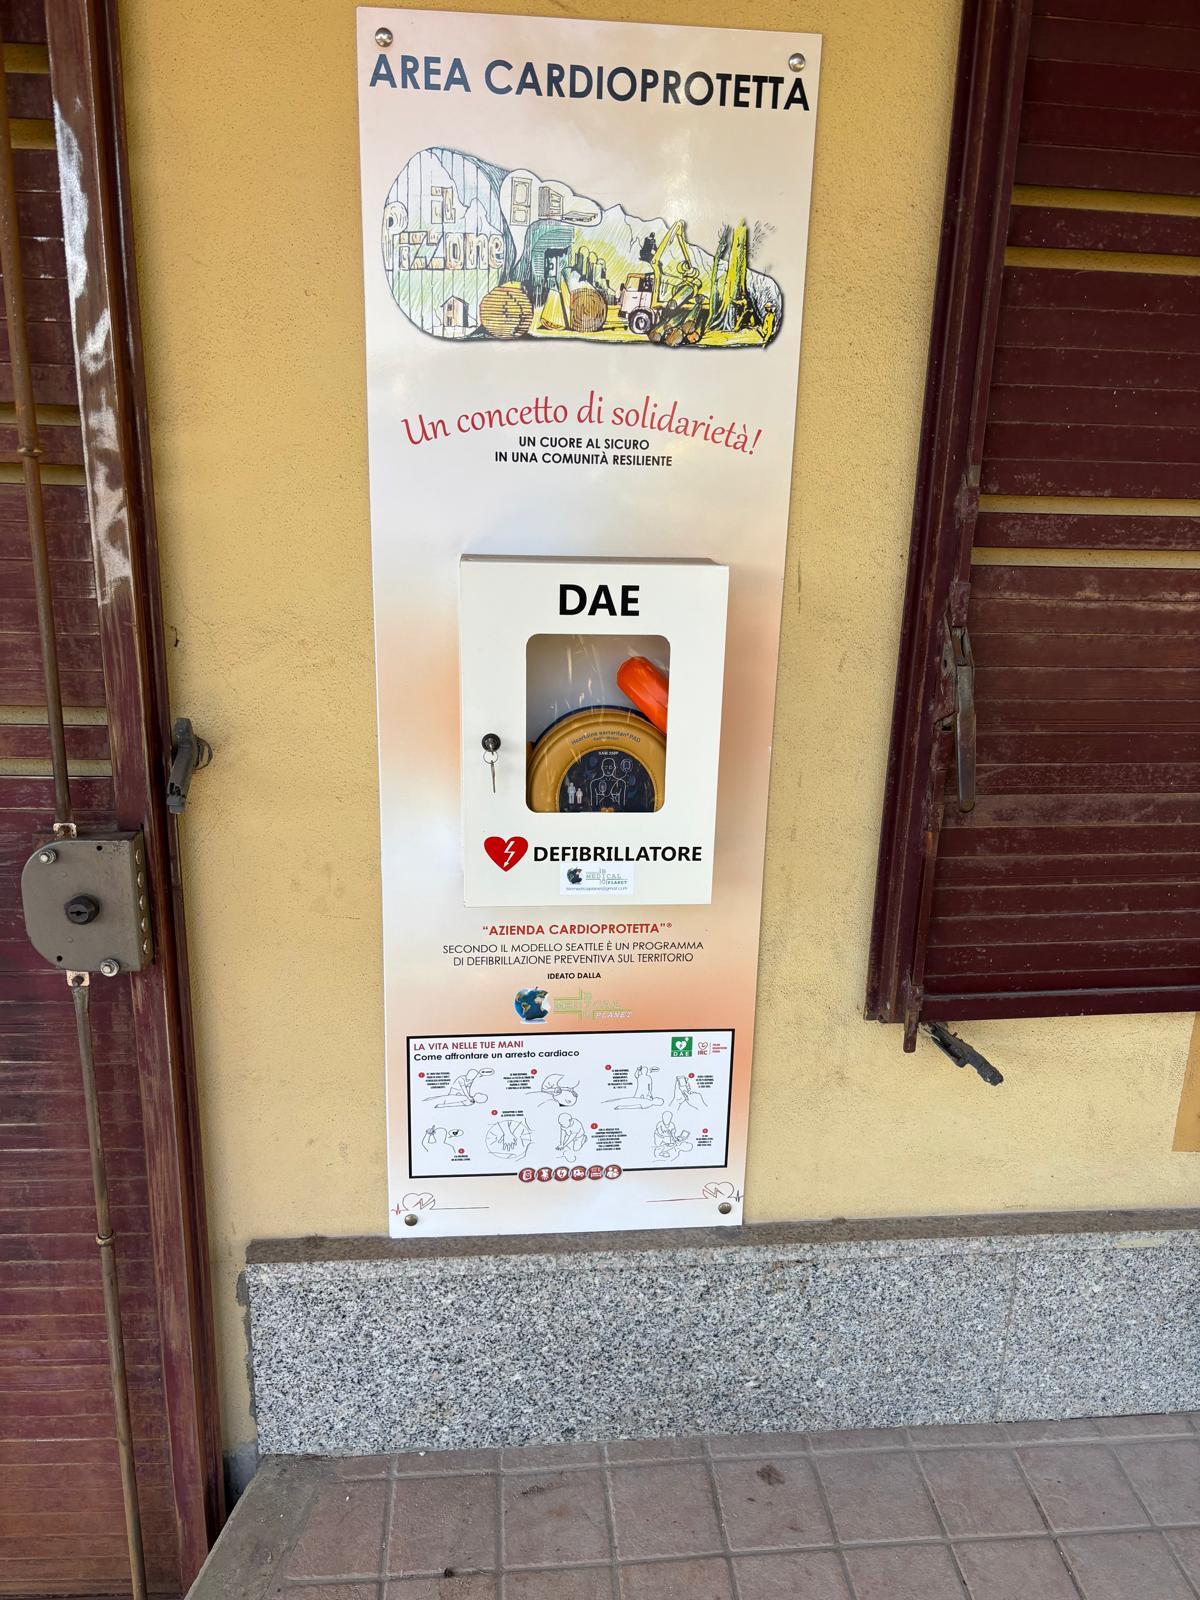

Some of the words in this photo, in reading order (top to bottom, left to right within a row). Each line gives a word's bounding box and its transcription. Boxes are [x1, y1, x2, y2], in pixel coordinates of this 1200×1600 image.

[369, 54, 471, 93] AREA
[484, 59, 810, 111] CARDIOPROTETTA
[401, 414, 451, 445] Un
[456, 396, 568, 433] concetto
[577, 390, 604, 424] di
[611, 395, 762, 455] solidarietà!
[519, 436, 536, 447] UN
[540, 437, 582, 448] CUORE
[586, 438, 600, 449] AL
[604, 438, 650, 450] SICURO
[495, 451, 508, 462] IN
[511, 452, 538, 463] UNA
[542, 452, 608, 465] COMUNITÀ
[612, 454, 672, 467] RESILIENTE
[559, 584, 640, 616] DAE
[533, 846, 702, 862] DEFIBRILLATORE
[443, 944, 498, 954] SECONDO
[500, 944, 508, 953] IL
[511, 943, 563, 952] MODELLO
[565, 942, 604, 951] SEATTLE
[606, 940, 613, 951] È
[615, 942, 630, 950] UN
[633, 941, 704, 950] PROGRAMMA
[453, 957, 464, 966] DI
[467, 955, 552, 966] DEFIBRILLAZIONE
[554, 954, 615, 964] PREVENTIVA
[618, 953, 635, 963] SUL
[638, 952, 694, 963] TERRITORIO
[413, 1043, 425, 1051] LA
[428, 1042, 449, 1050] VITA
[452, 1041, 478, 1049] NELLE
[480, 1041, 496, 1049] TUE
[498, 1040, 524, 1048] MANI
[413, 1053, 442, 1061] Come
[445, 1052, 489, 1060] affrontare
[505, 1050, 536, 1058] arresto
[538, 1049, 580, 1058] cardiaco
